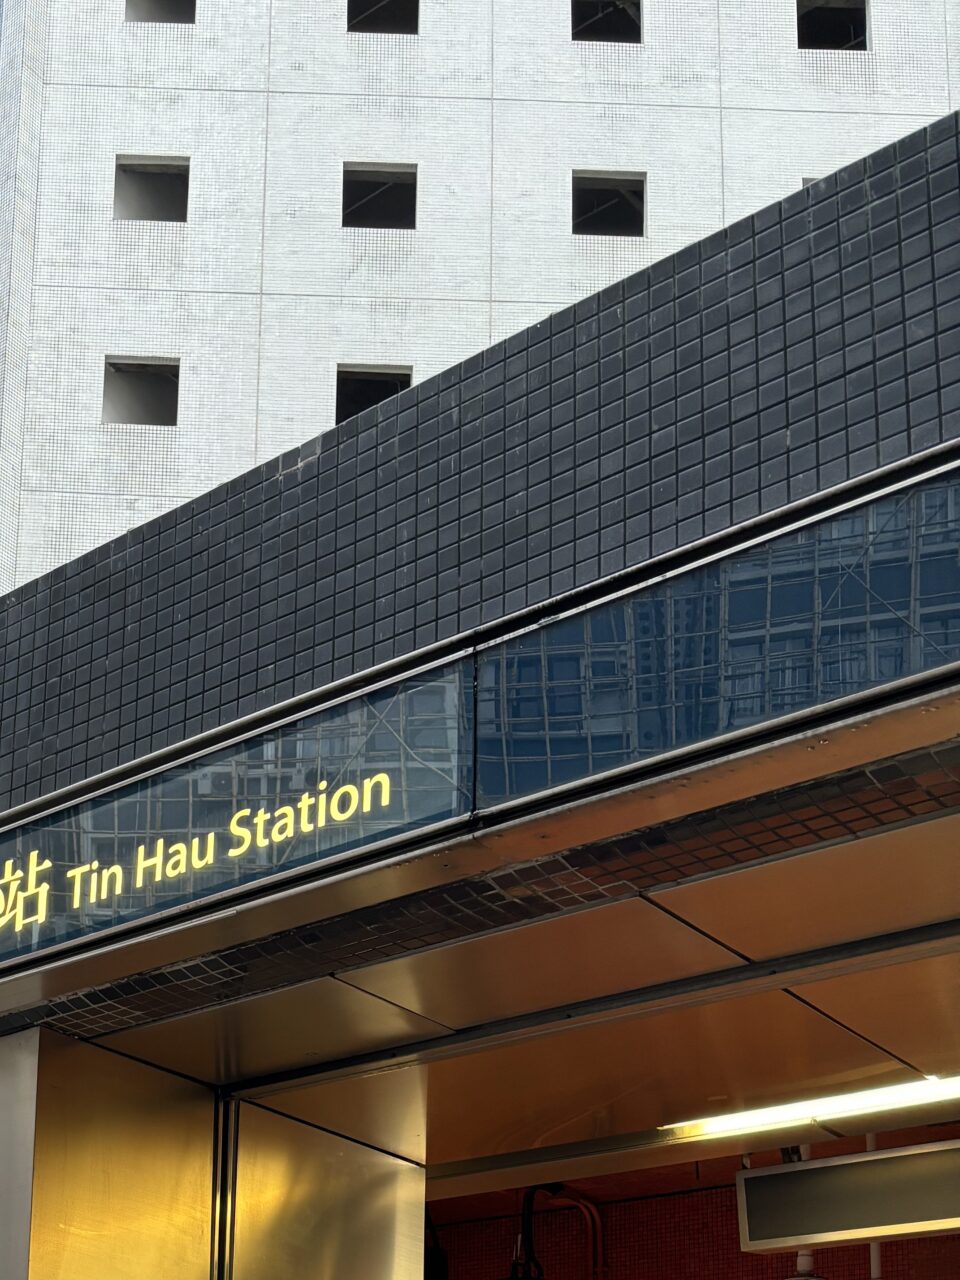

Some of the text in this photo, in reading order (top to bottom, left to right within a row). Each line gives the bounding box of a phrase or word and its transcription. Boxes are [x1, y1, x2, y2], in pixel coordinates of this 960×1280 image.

[66, 772, 391, 910] Tin Hau Station
